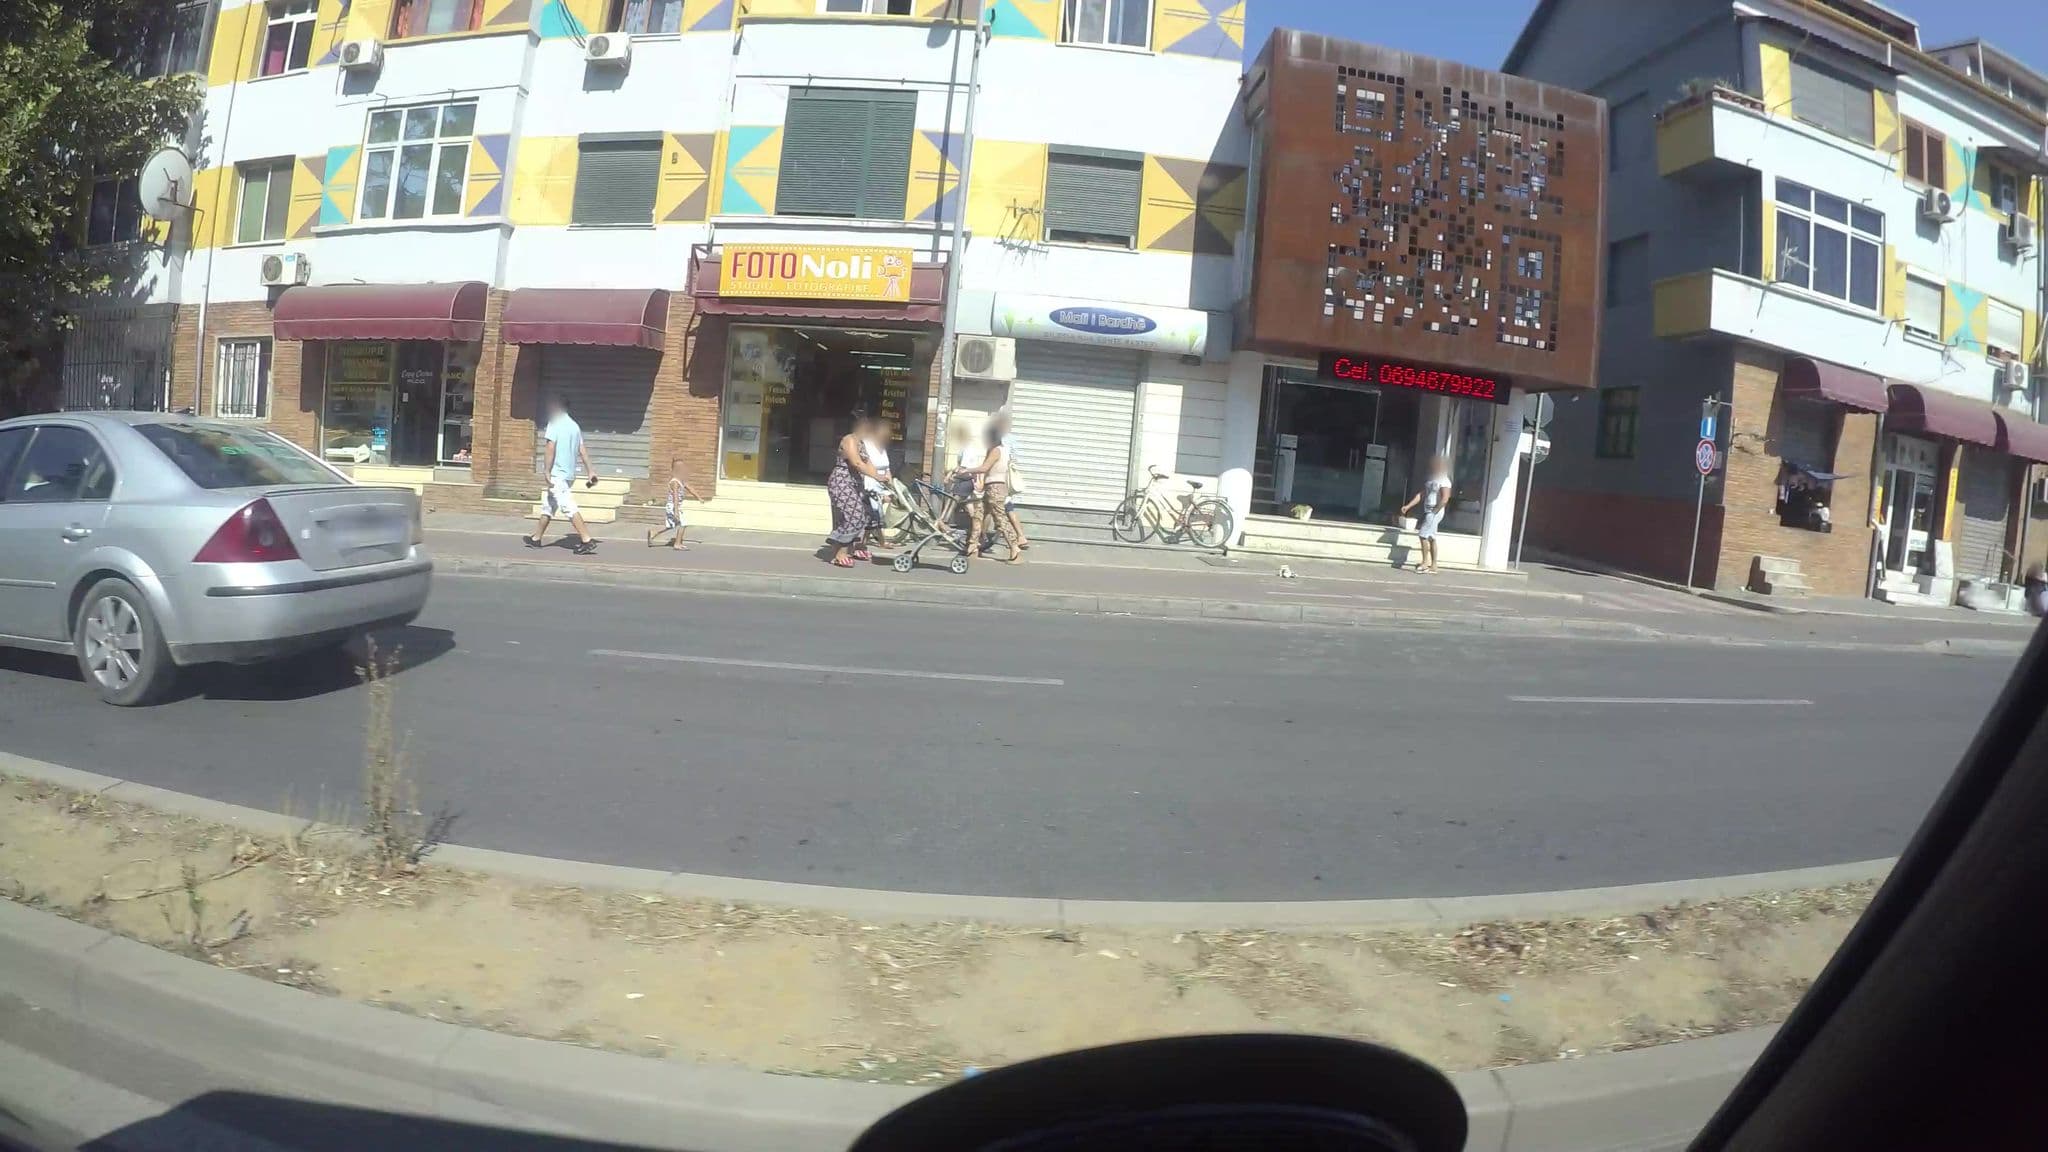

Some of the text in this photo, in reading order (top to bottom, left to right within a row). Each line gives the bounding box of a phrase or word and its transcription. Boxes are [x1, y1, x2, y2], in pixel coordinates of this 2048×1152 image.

[732, 251, 872, 280] FOTO Noli
[1334, 358, 1372, 381] Cel.
